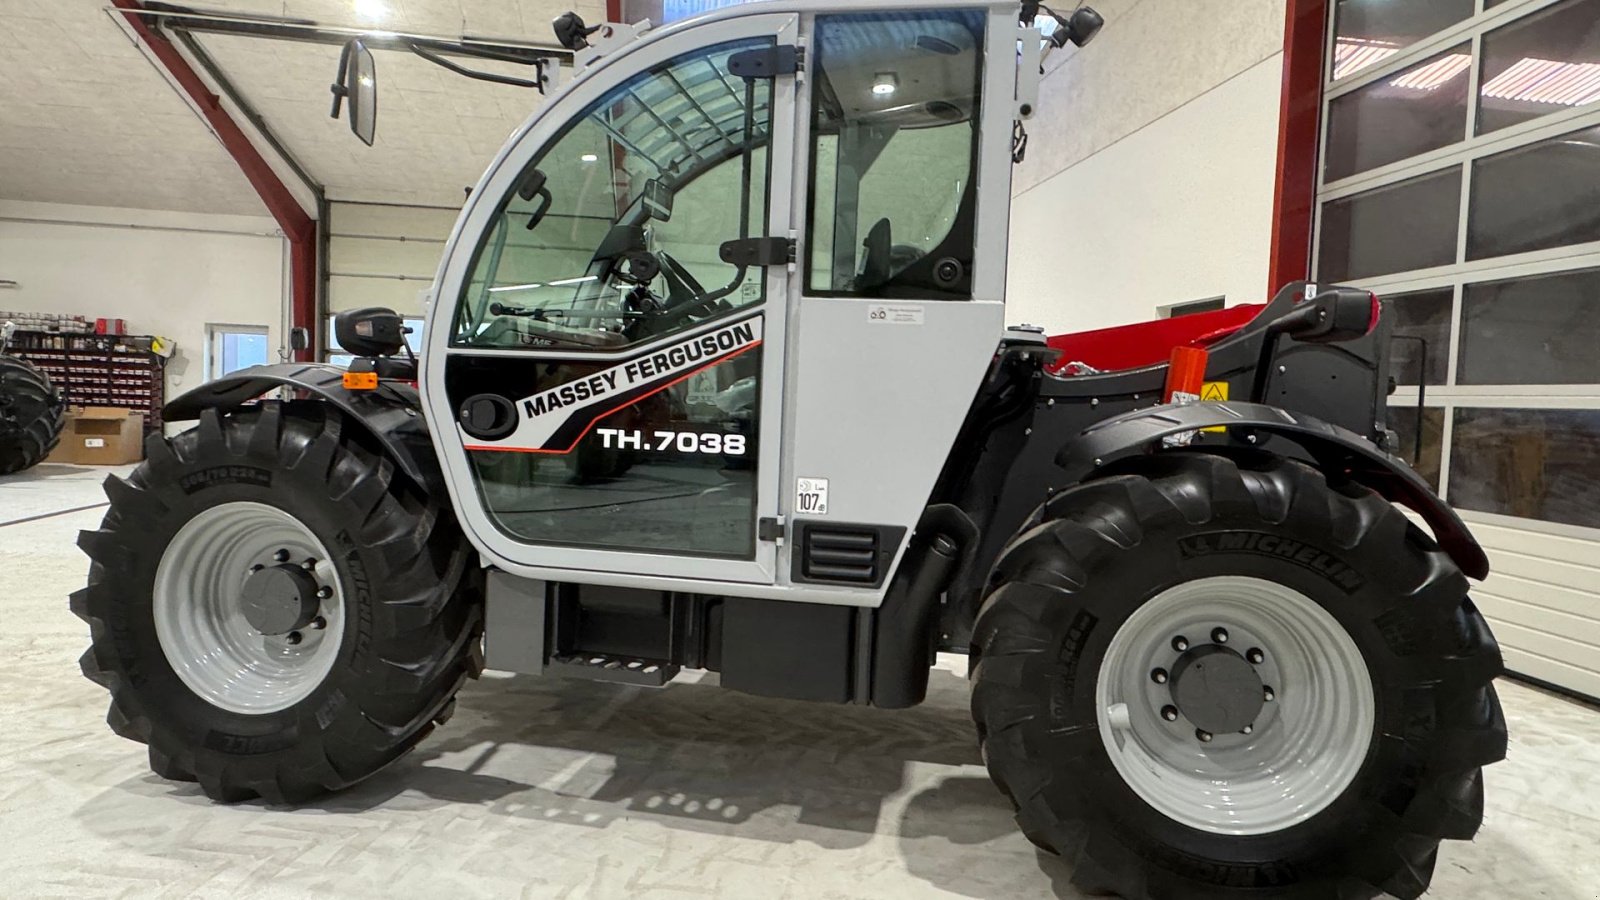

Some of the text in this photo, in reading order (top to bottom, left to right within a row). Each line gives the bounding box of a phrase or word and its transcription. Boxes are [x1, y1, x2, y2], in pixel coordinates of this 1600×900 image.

[525, 323, 755, 419] MASSEY FERGUSON
[597, 428, 747, 455] TH.7038
[799, 493, 820, 511] 107
[1217, 532, 1364, 590] MICHELIN
